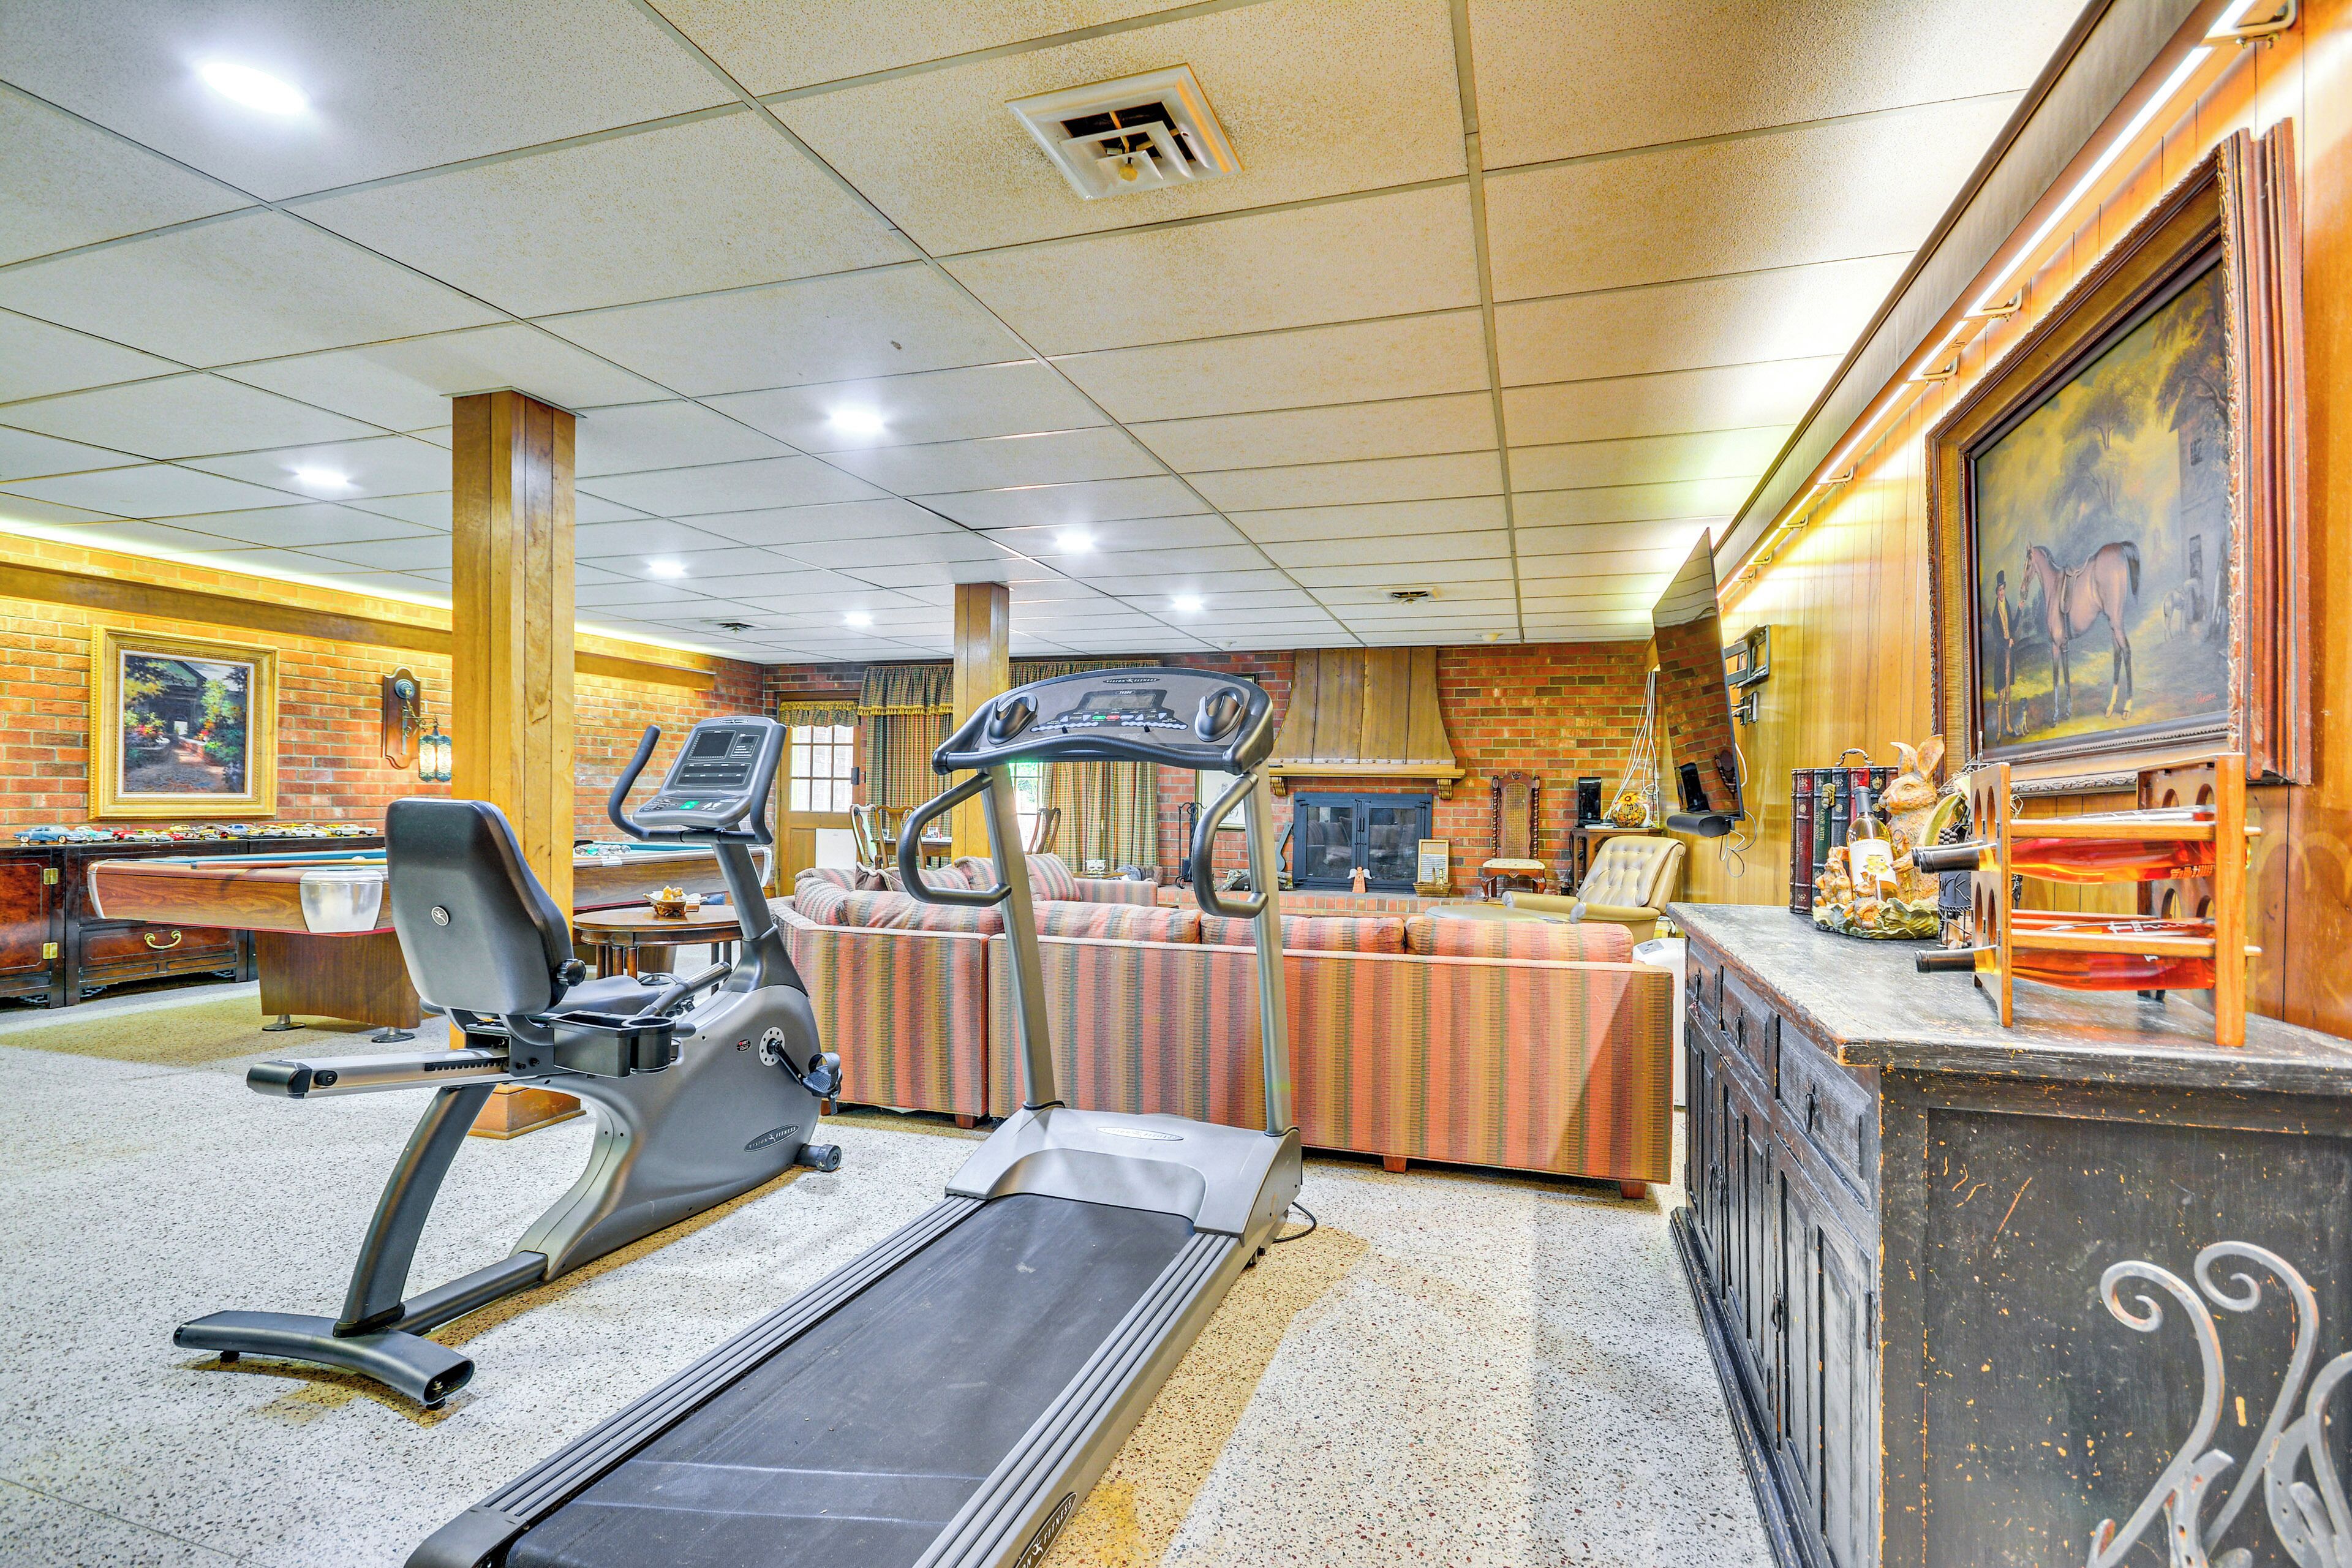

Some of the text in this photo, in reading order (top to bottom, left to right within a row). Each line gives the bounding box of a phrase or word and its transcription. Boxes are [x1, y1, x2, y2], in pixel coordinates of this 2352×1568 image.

[749, 1127, 796, 1148] VISION FITNESS
[1044, 1499, 1072, 1544] FITNESS
